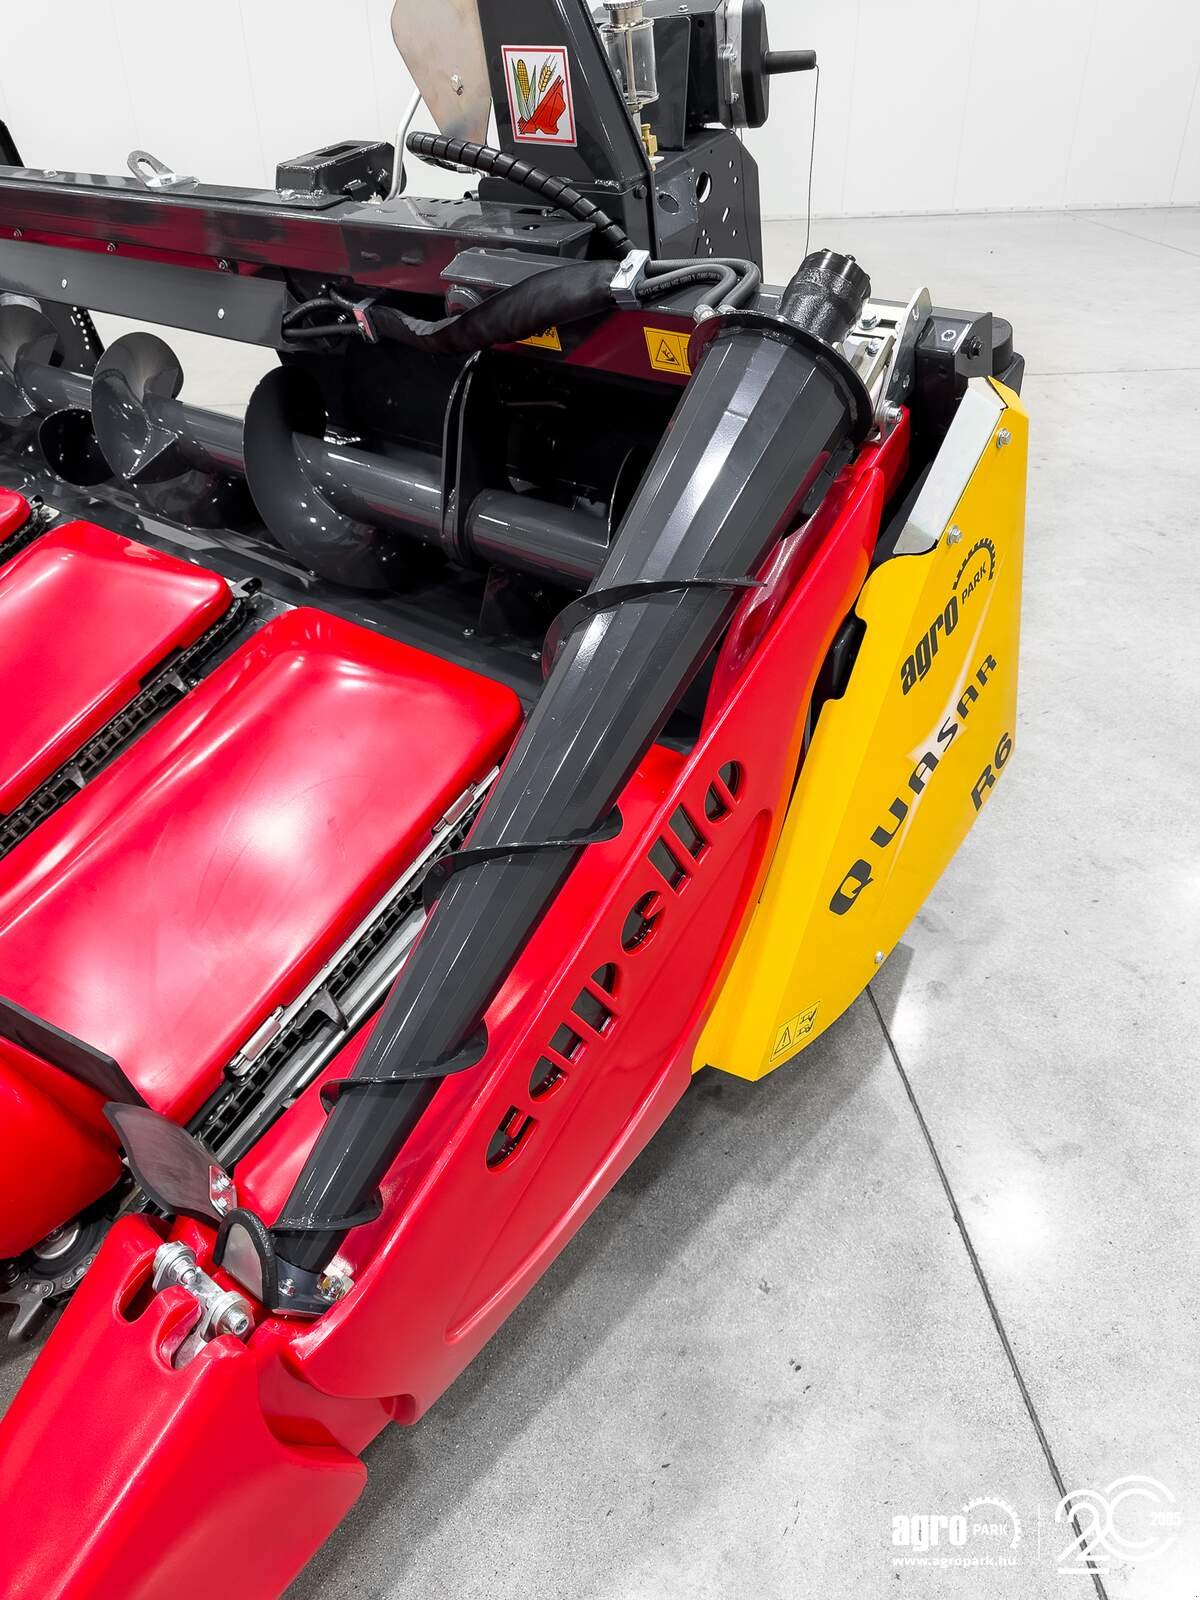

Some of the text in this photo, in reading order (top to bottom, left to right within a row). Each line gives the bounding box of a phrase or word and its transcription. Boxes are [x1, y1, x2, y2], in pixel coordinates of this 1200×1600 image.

[900, 561, 987, 696] agro PARK
[829, 653, 998, 916] QUASAR
[970, 731, 1014, 812] R6
